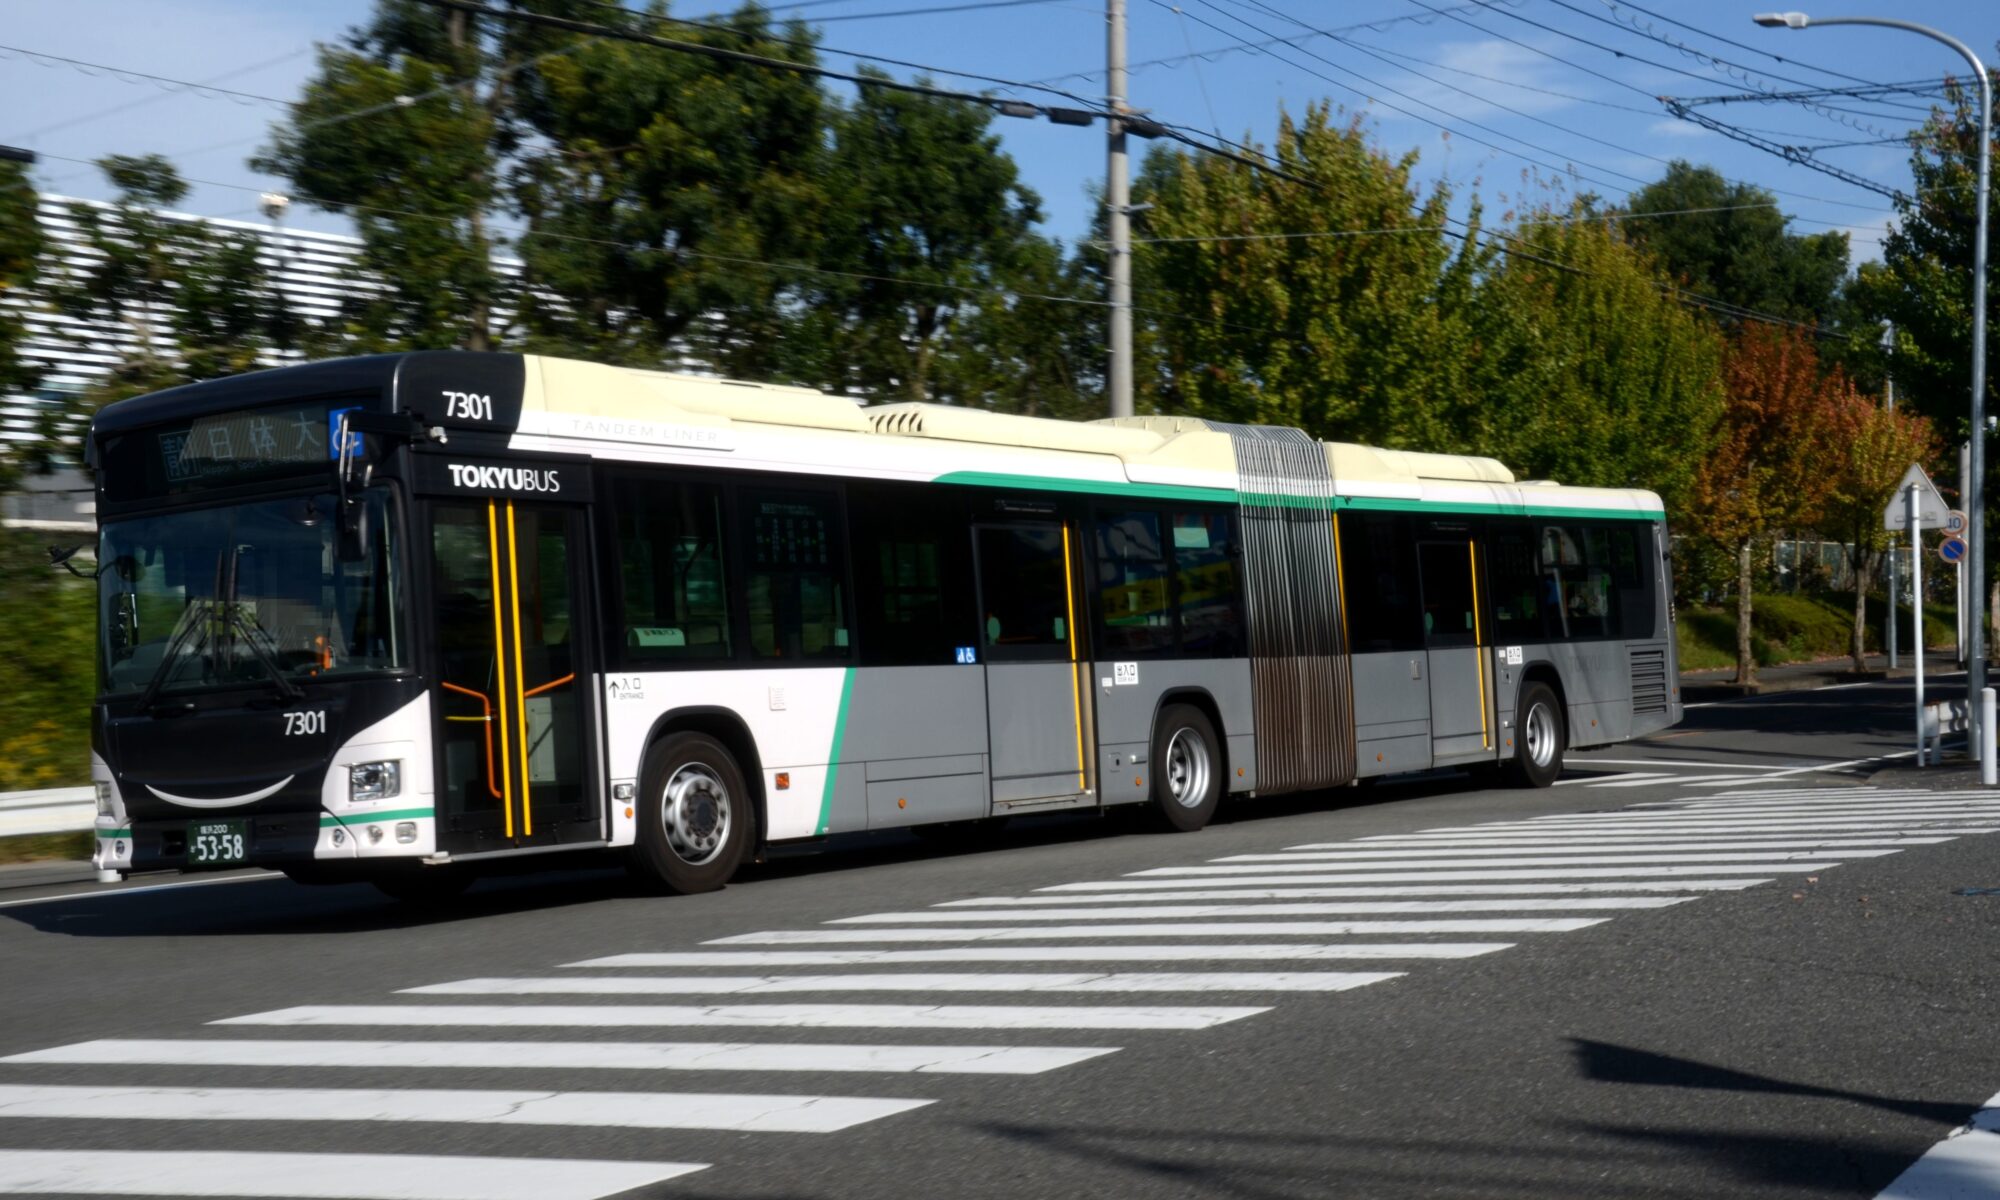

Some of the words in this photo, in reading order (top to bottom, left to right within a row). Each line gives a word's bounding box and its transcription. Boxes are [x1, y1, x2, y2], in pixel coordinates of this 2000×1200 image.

[441, 390, 493, 421] 7301
[572, 419, 654, 437] TANDEM
[663, 429, 718, 442] LINER
[622, 677, 641, 690] 入口
[282, 710, 326, 736] 7301
